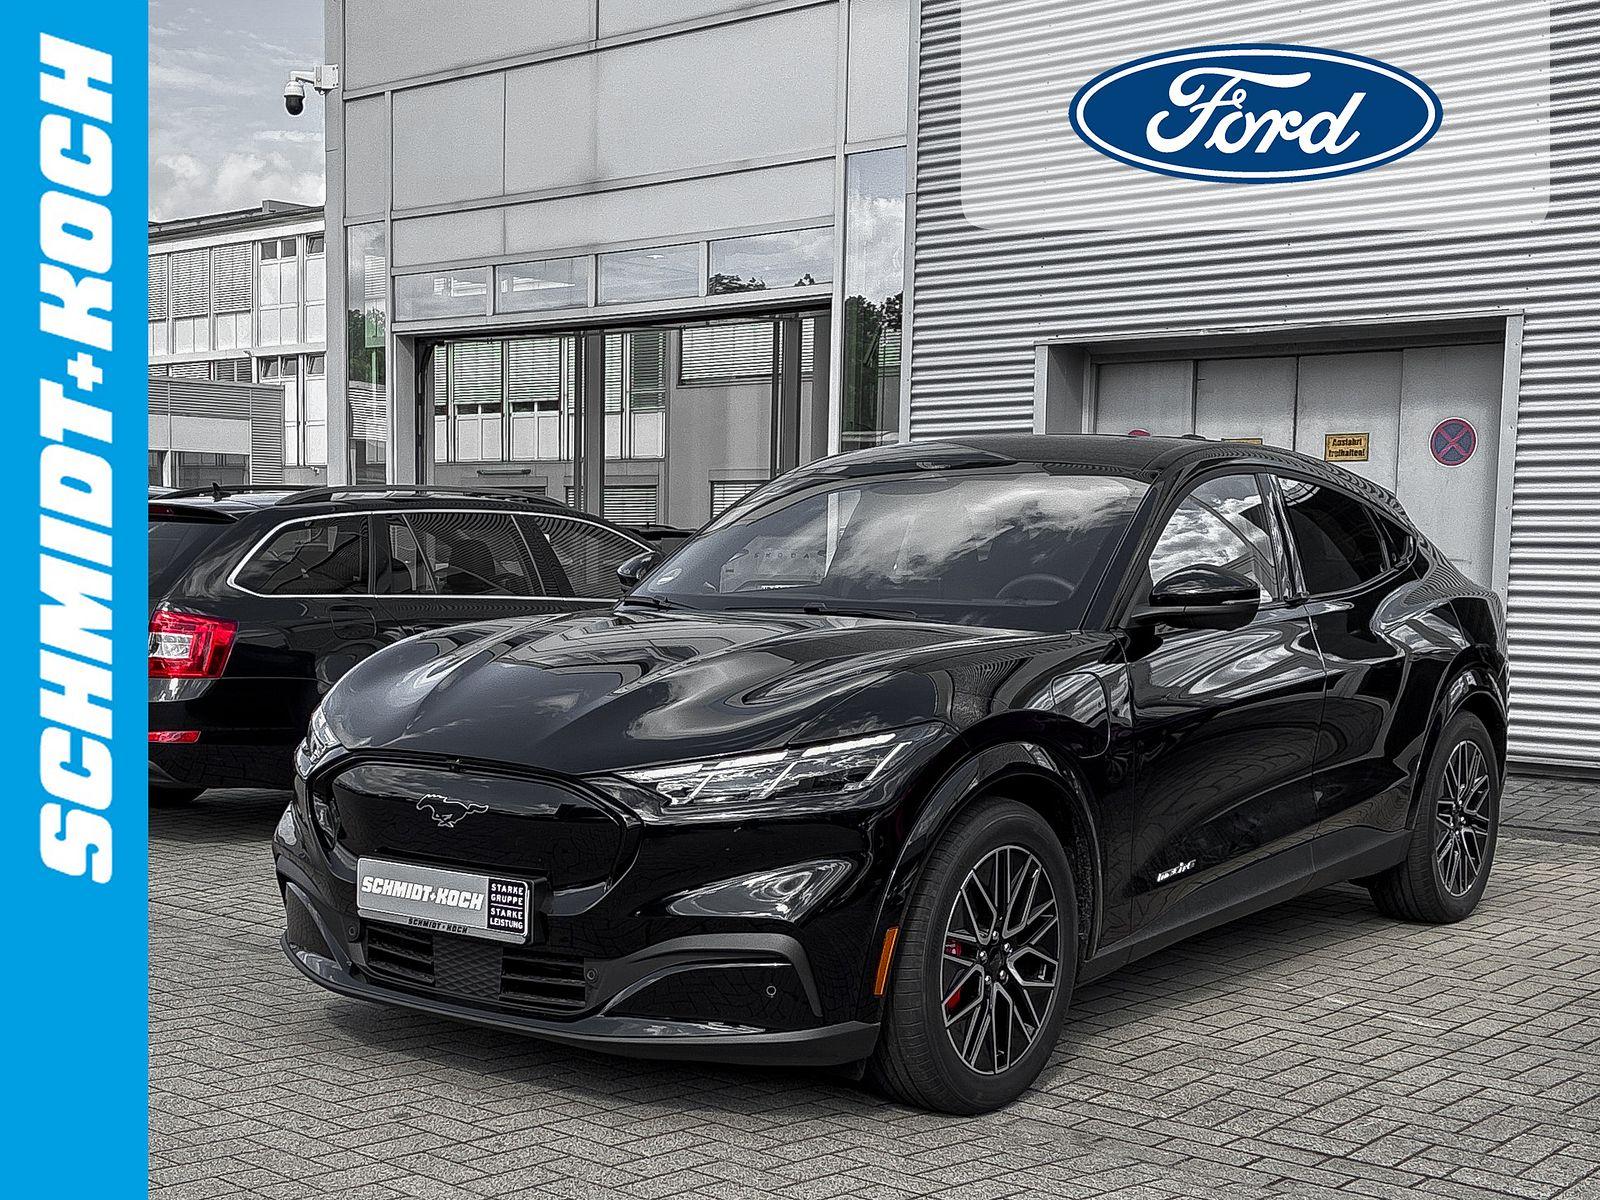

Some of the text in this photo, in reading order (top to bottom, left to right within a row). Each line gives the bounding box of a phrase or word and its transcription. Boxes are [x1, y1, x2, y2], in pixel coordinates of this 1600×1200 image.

[361, 876, 484, 911] SCHMIDT+KOCH
[491, 883, 524, 895] STARKE
[491, 893, 523, 906] GRUPPE
[490, 907, 523, 920] STARKE
[490, 917, 523, 930] LEISTUNG
